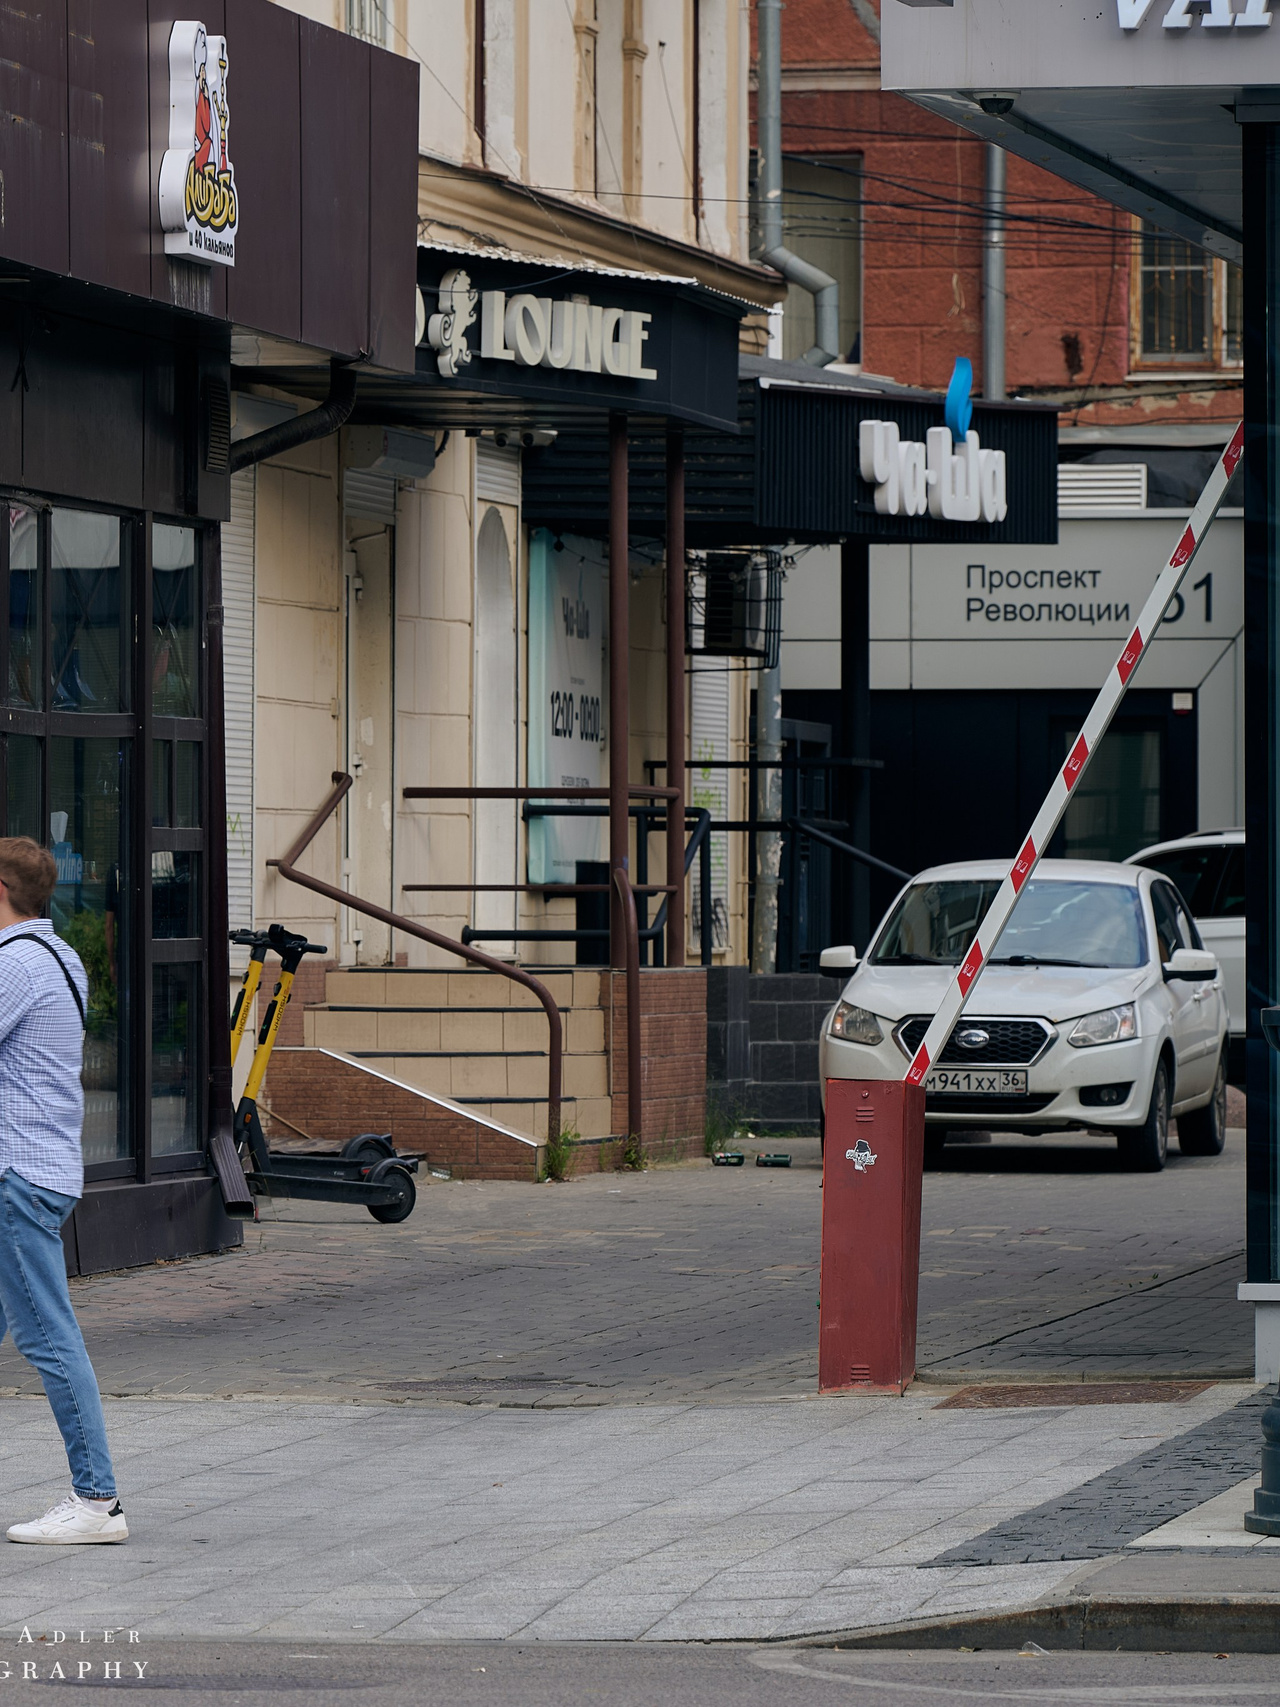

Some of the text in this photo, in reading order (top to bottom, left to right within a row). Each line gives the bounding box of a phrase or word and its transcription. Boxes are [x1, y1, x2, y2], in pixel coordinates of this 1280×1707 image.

[481, 290, 657, 380] LOUNGE
[967, 564, 1102, 594] Проспект
[966, 598, 1130, 625] Революции
[551, 691, 574, 739] 12:00
[579, 694, 601, 743] 00:00
[1002, 1072, 1020, 1086] 36
